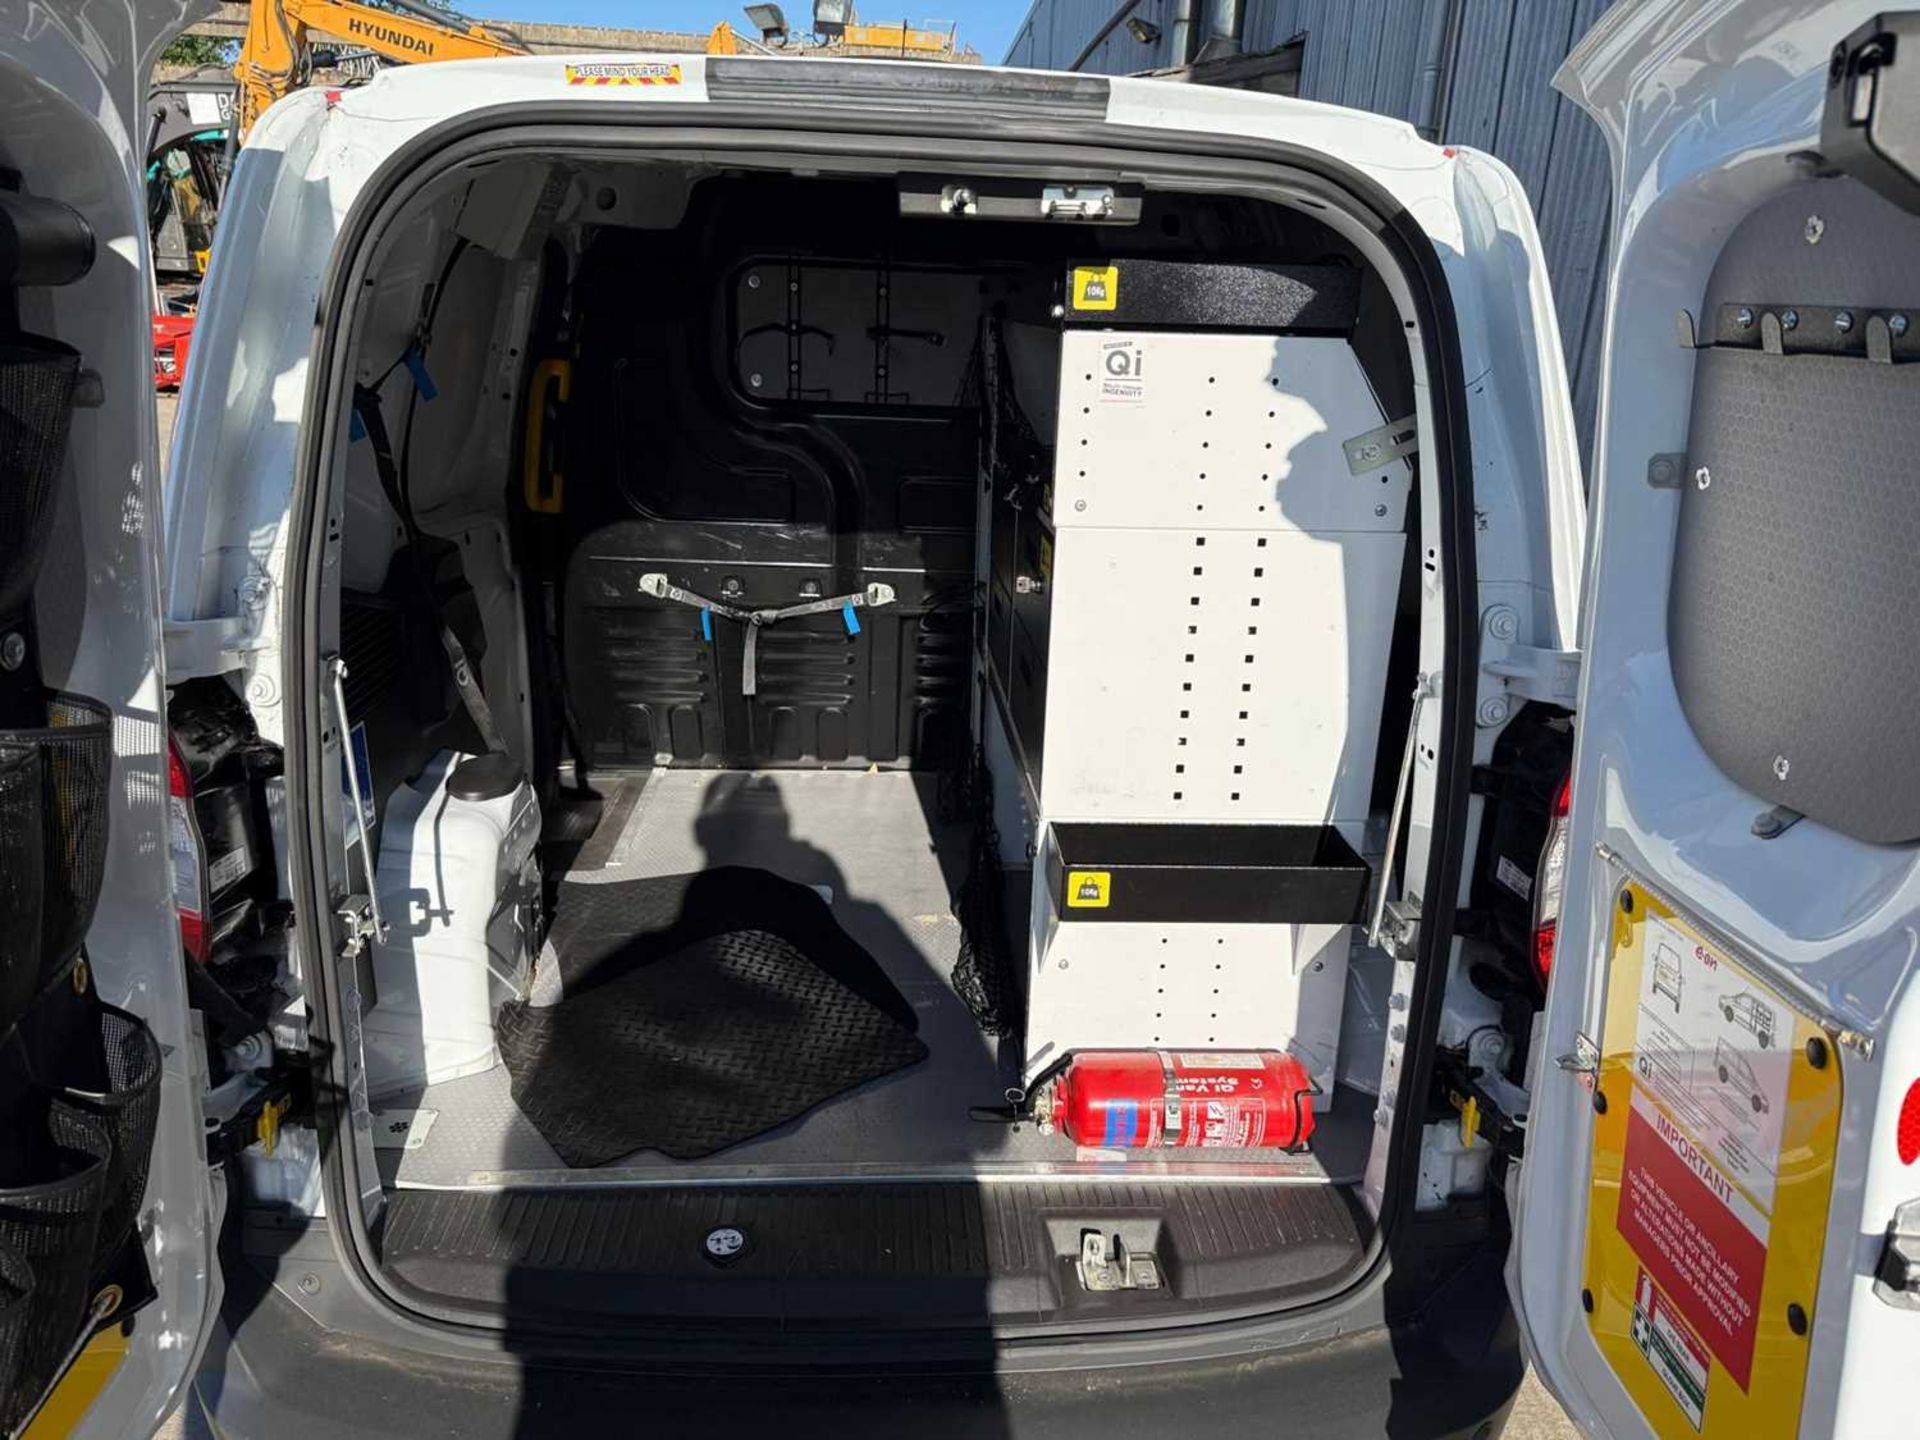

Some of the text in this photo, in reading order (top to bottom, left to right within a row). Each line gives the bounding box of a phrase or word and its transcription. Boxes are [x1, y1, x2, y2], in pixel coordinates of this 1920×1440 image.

[348, 18, 434, 56] HYUNDAI
[575, 65, 670, 76] PLEASE MIND YOUR HEAD
[1106, 350, 1142, 376] Qi
[1656, 1114, 1734, 1203] IMPORTANT
[1654, 1182, 1683, 1221] VEHICLE
[1695, 1229, 1740, 1286] ANCILLARY
[1664, 1210, 1685, 1240] MUST
[1684, 1233, 1700, 1258] NOT
[1712, 1265, 1751, 1317] MODIFIED
[1684, 1251, 1707, 1284] MADE
[1706, 1277, 1743, 1327] WITHOUT
[1692, 1277, 1734, 1334] APPROVAL
